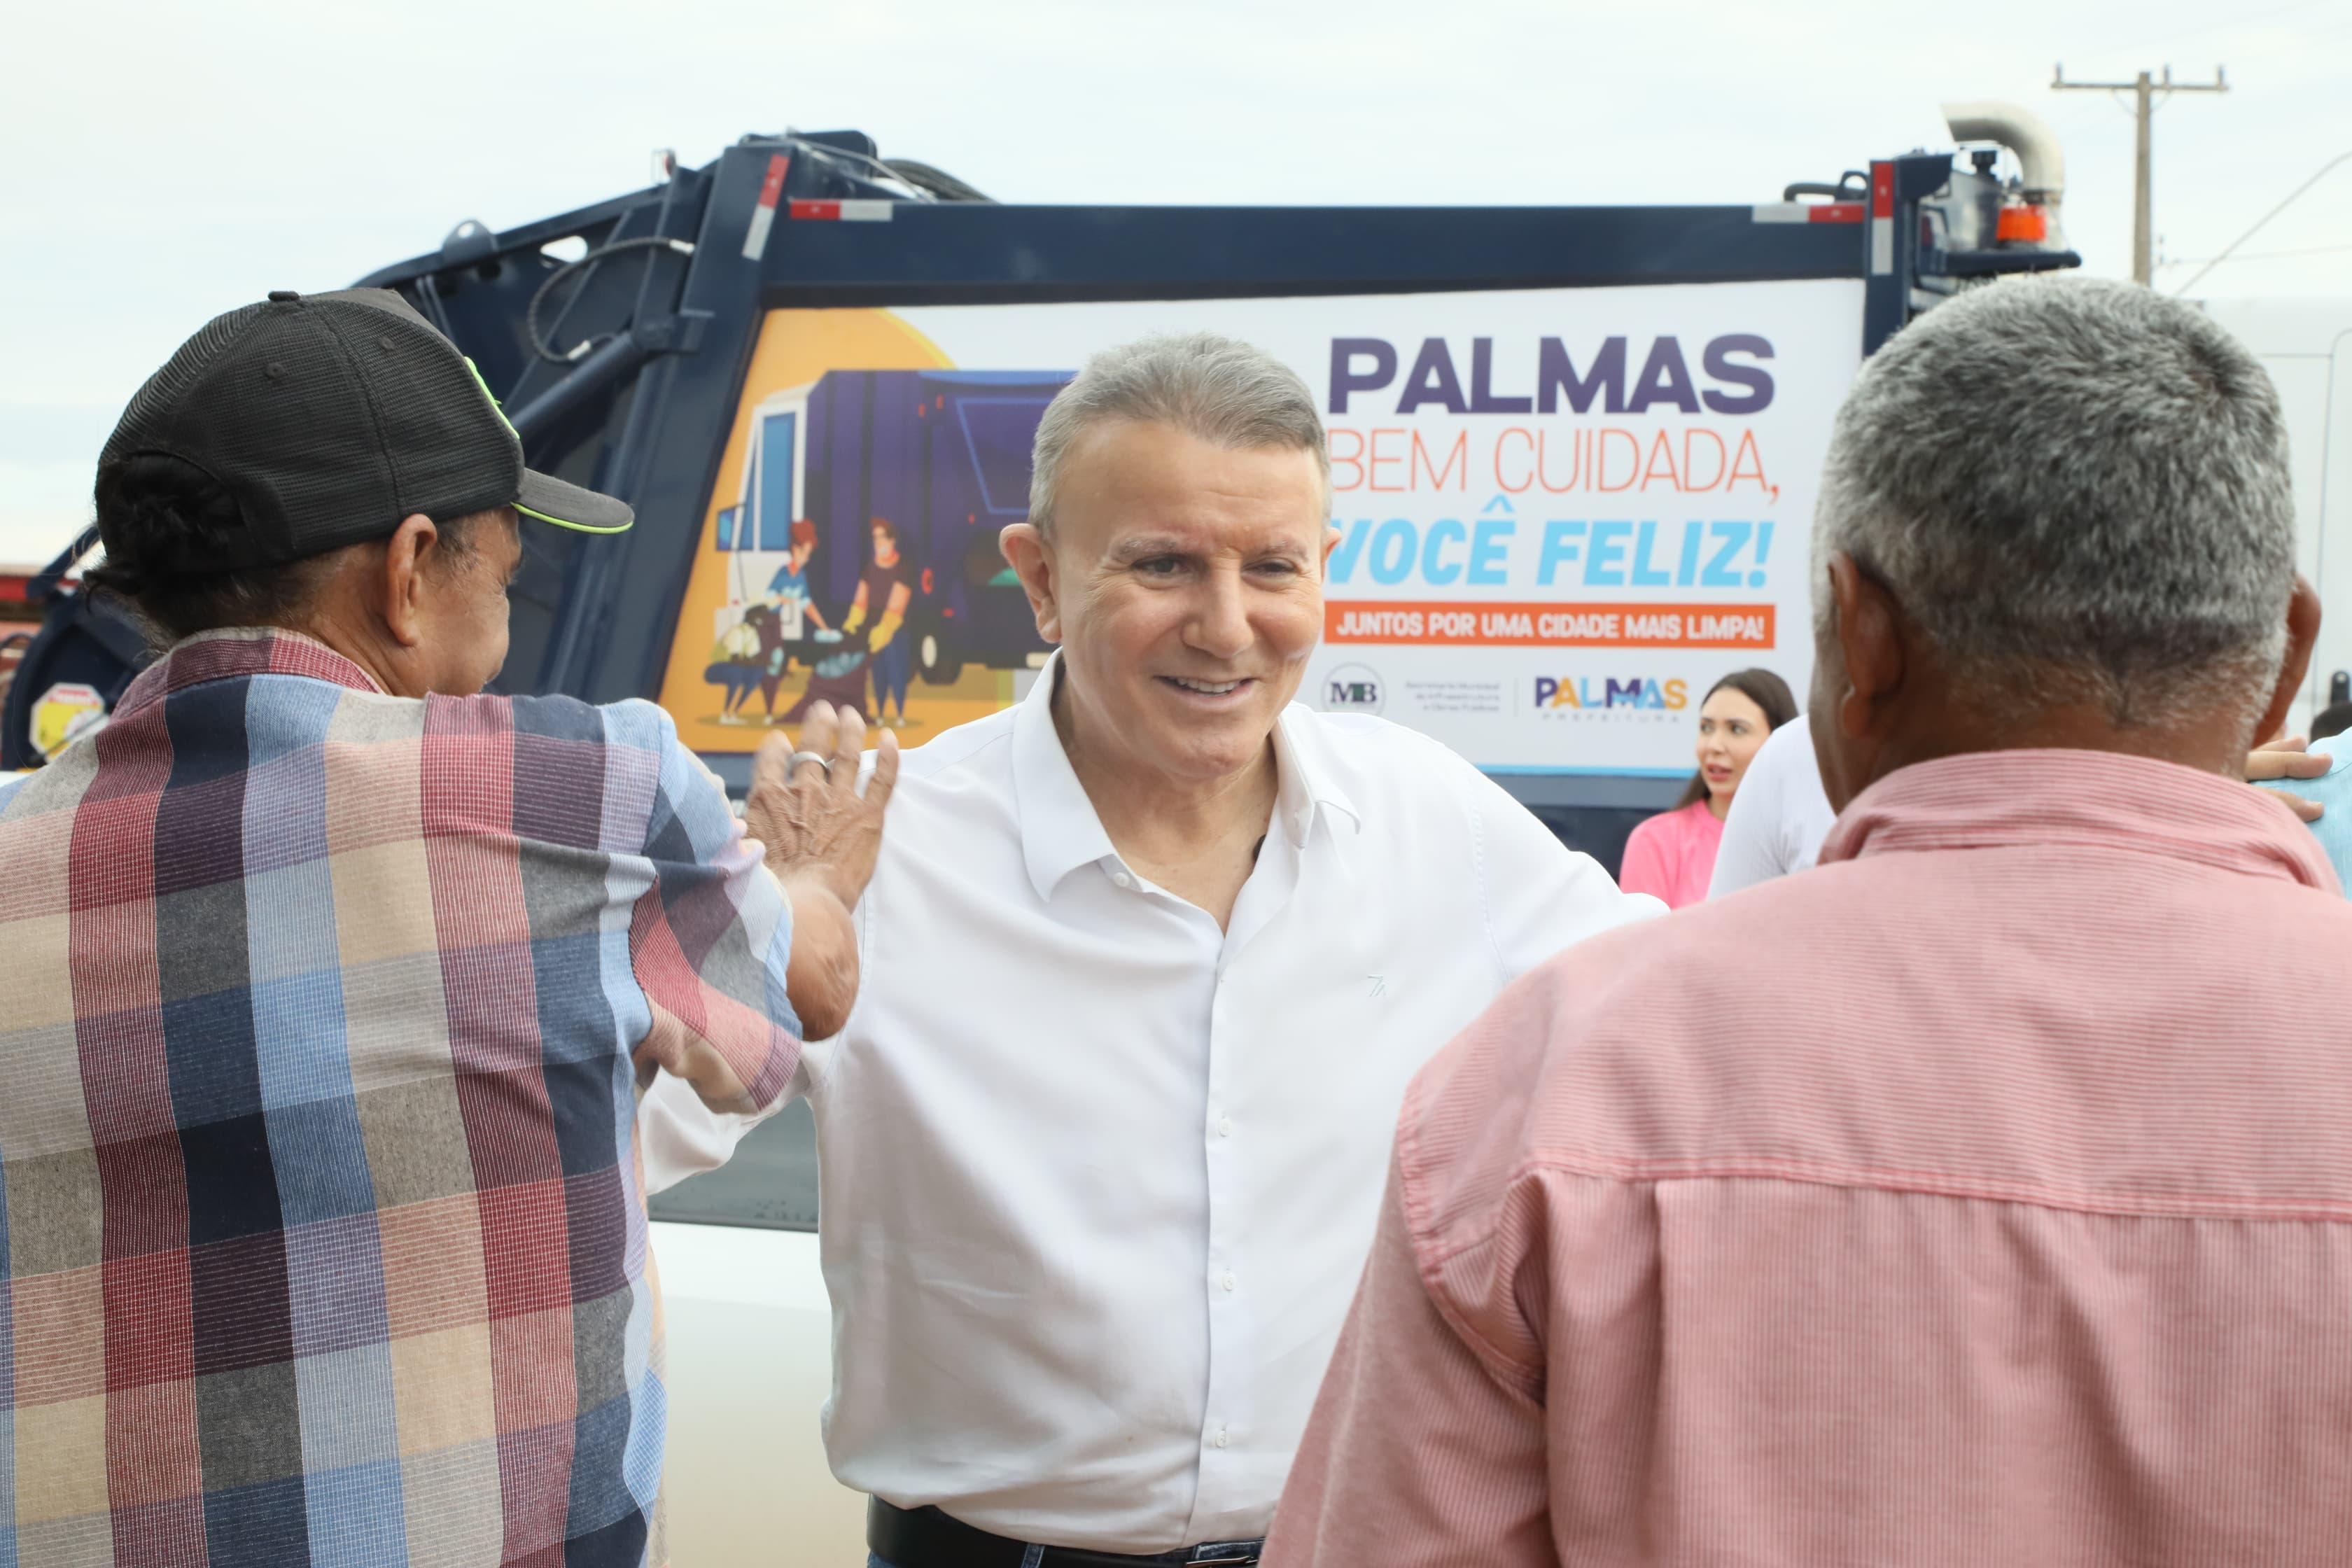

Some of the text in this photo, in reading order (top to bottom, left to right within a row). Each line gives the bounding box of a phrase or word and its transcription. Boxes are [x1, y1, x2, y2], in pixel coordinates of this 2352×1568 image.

[1329, 333, 1775, 415] PALMAS
[1327, 428, 1779, 505] BEM CUIDADA,
[1326, 493, 1775, 588] VOCÊ FELIZ!
[1336, 611, 1765, 640] JUNTOS POR UMA CIDADE MAIS LIMPA!
[1535, 677, 1688, 710] PALMAS
